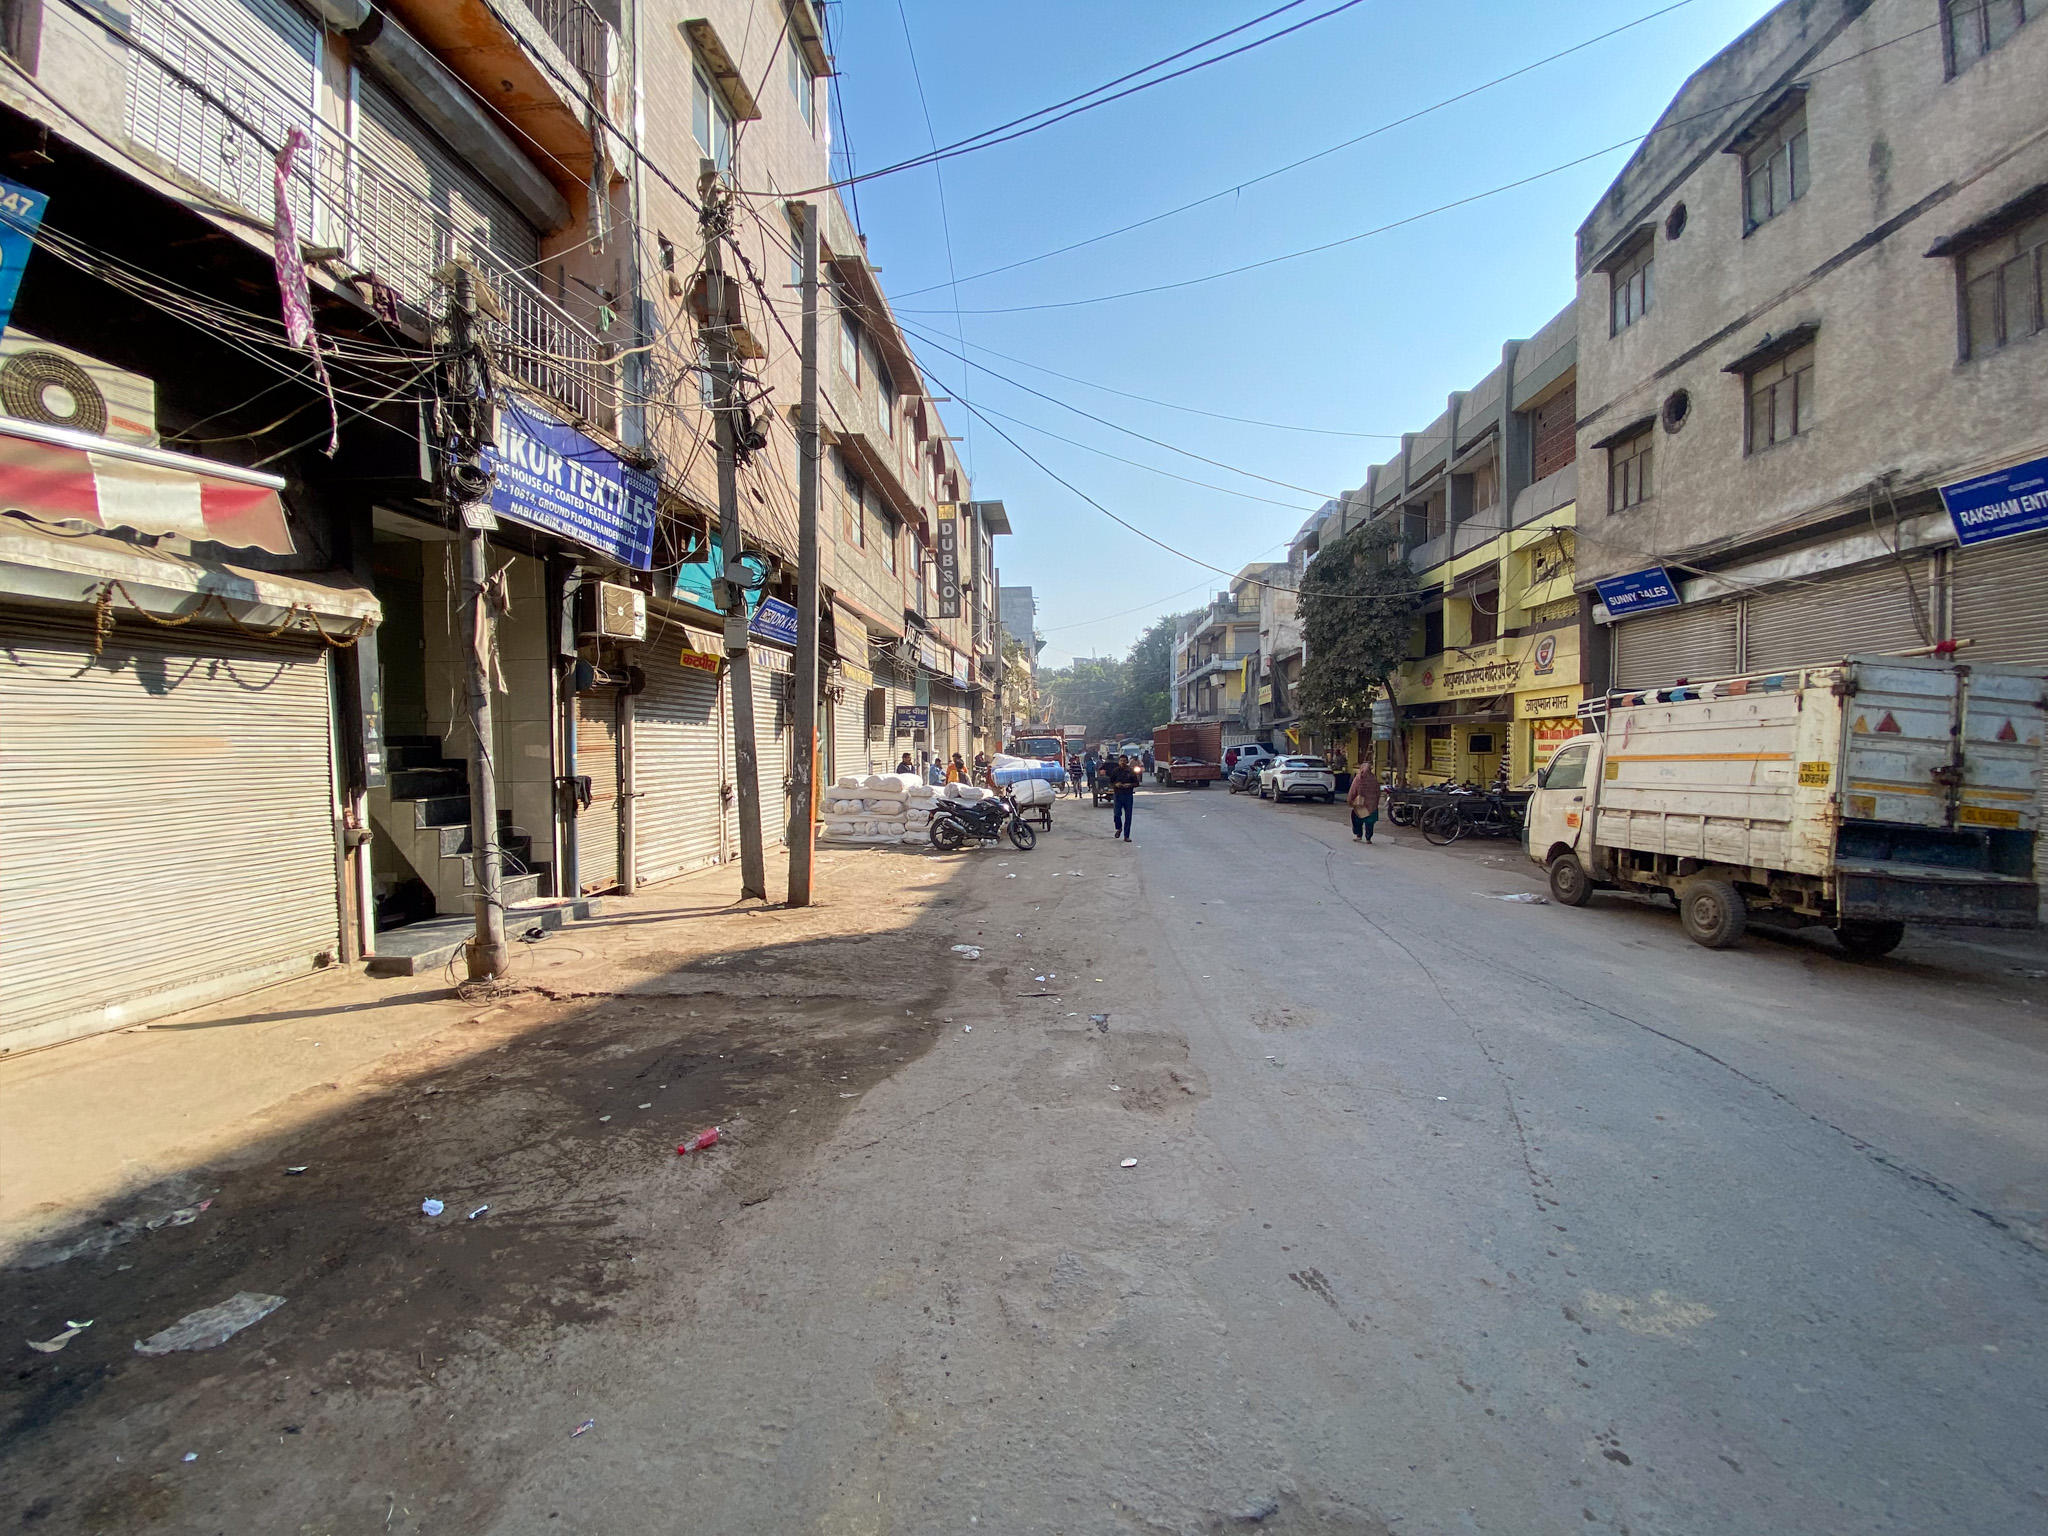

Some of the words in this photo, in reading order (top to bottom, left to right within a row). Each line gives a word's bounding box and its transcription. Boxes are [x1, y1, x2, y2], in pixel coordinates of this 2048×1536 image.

[0, 186, 34, 216] 47
[482, 421, 563, 486] NKUR
[567, 458, 653, 529] TEXTILES
[511, 466, 542, 491] HOUSE
[543, 481, 555, 496] OF
[555, 488, 584, 510] COATED
[584, 502, 612, 523] TEXTILE
[612, 515, 637, 535] FABRICS
[1960, 499, 2021, 526] RAKSHAM
[2020, 490, 2048, 513] ENT
[510, 501, 532, 519] NABI
[561, 522, 579, 537] NEW
[538, 497, 570, 519] GROUND
[571, 511, 592, 529] FLOOR
[635, 541, 650, 555] ROAD
[941, 522, 956, 614] DUBSON
[1608, 592, 1637, 606] SUNNY
[771, 612, 790, 628] DRK
[683, 653, 717, 672] कटपीस
[1525, 697, 1551, 714] आयुष्मान
[1551, 694, 1569, 709] भारत
